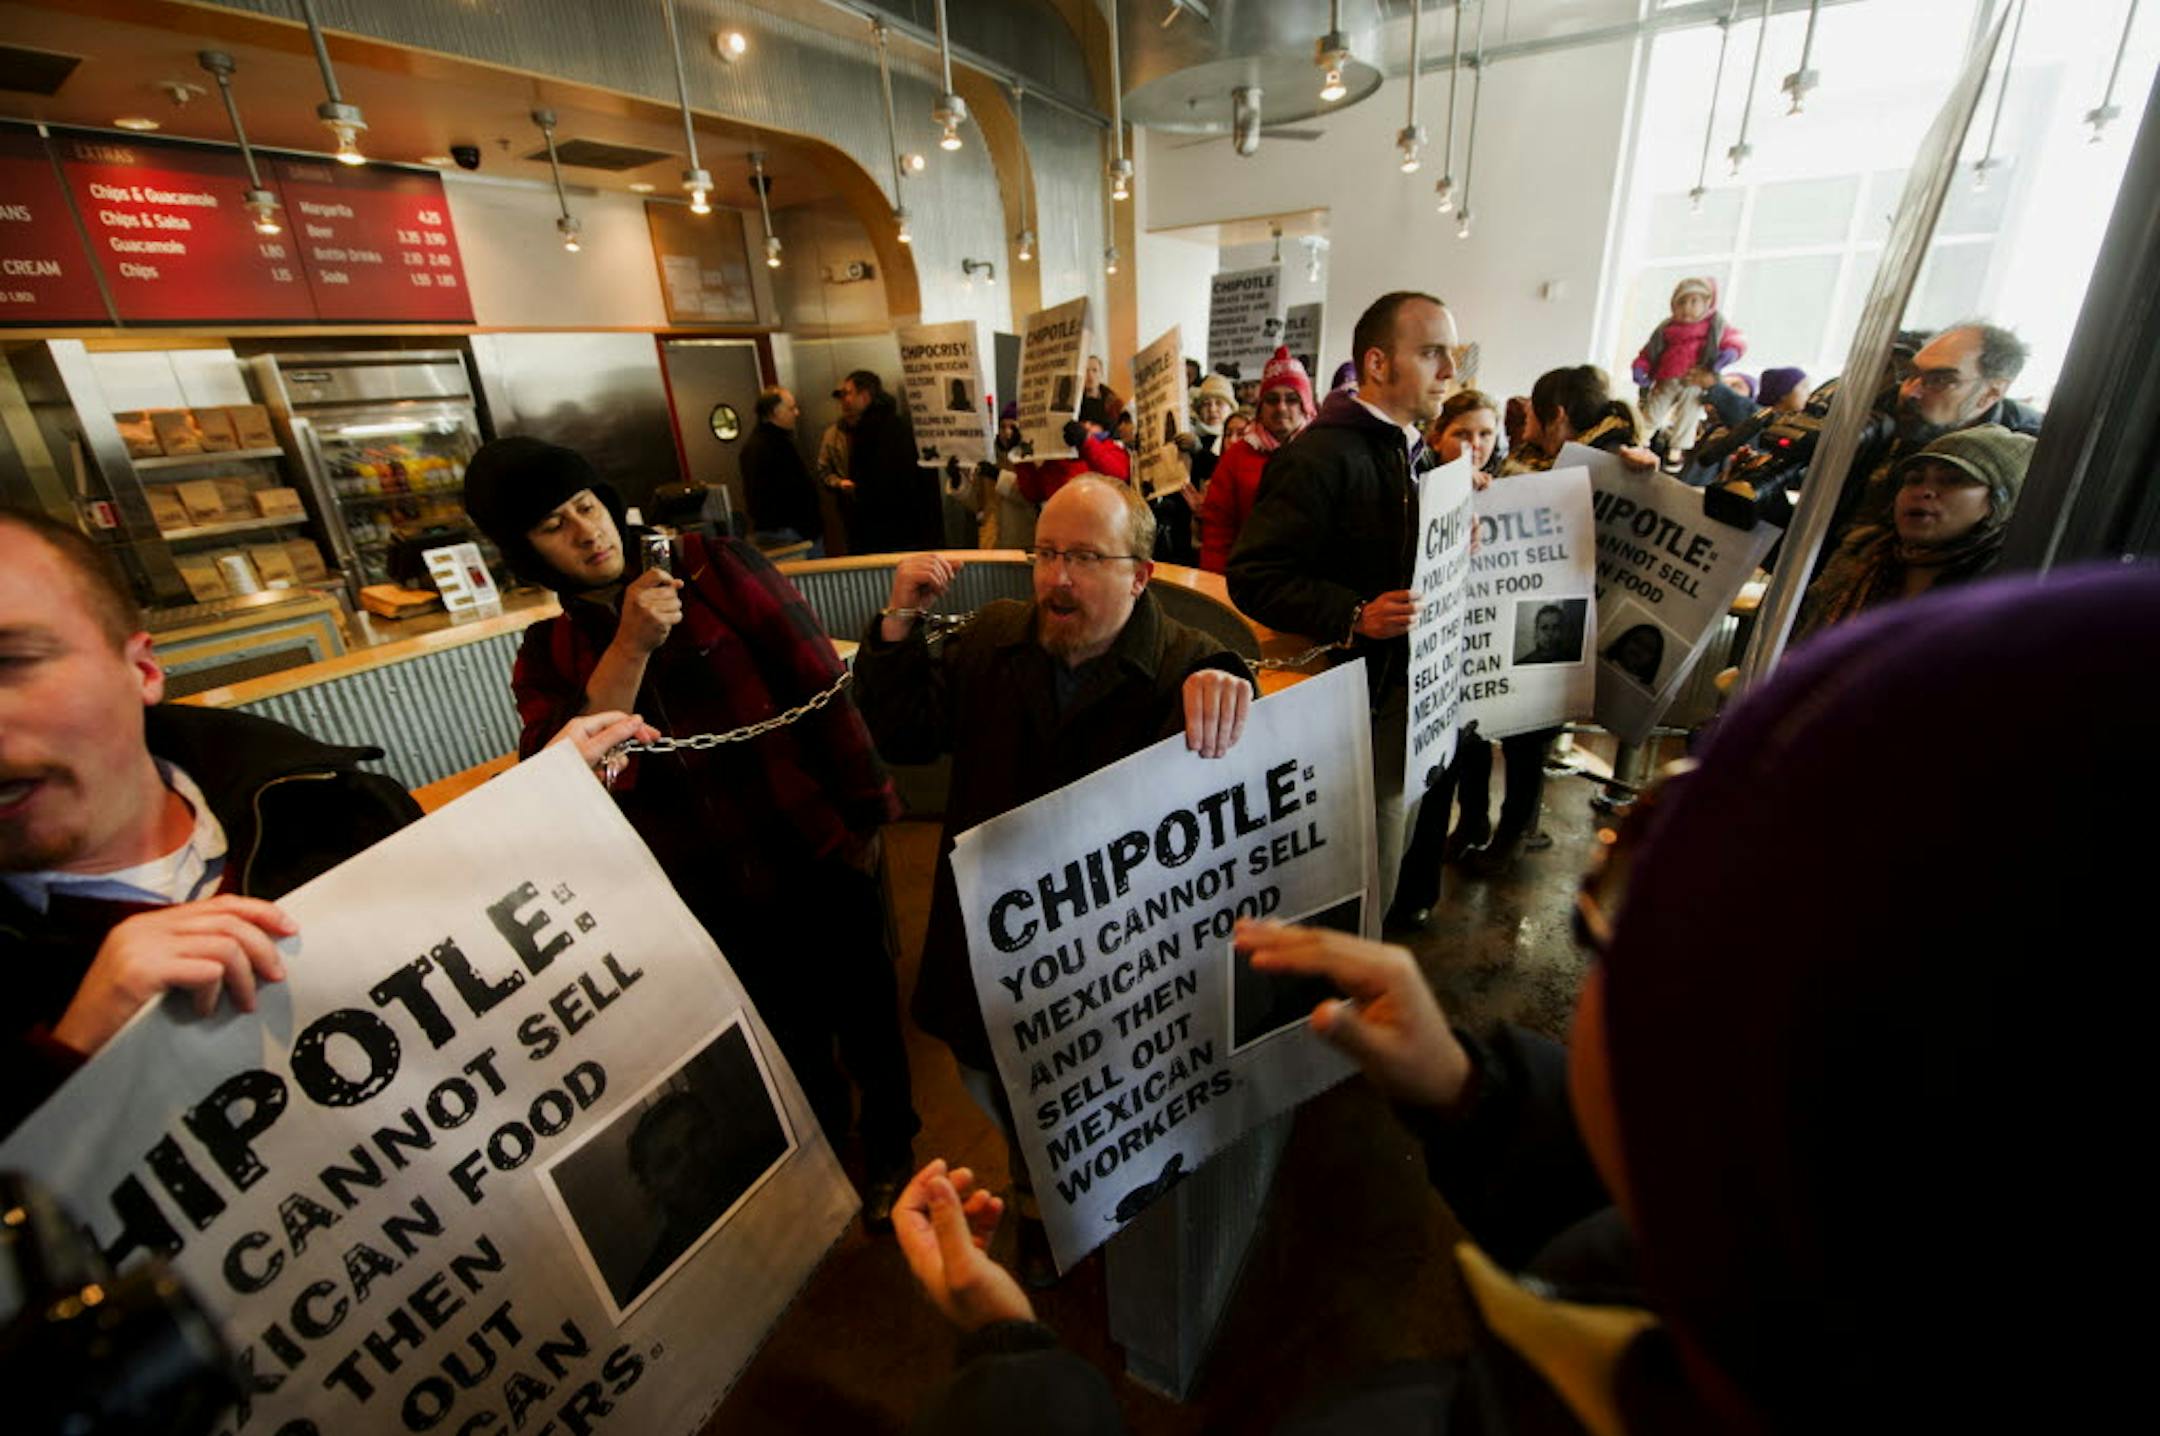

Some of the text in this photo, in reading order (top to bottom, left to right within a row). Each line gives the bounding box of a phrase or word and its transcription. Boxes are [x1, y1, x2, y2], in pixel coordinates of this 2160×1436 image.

[90, 183, 218, 207] Chips & Guacamole
[100, 210, 191, 231] Chips & Salsa
[109, 237, 187, 255] Guacamole
[3, 259, 62, 277] CREAM
[119, 262, 160, 280] Chips
[1479, 507, 1563, 546] OTLE:
[1470, 550, 1520, 573] NNOT
[1525, 543, 1569, 564] SELL
[1496, 573, 1543, 595] FOOD
[1614, 568, 1664, 604] FOOD
[1658, 562, 1700, 600] SELL
[1463, 606, 1497, 627] HEN
[1414, 661, 1440, 694] SELL
[988, 759, 1318, 954] CHIPOTLE:
[1000, 821, 1327, 1004] YOU CANNOT SELL
[1013, 932, 1181, 1053] MEXICAN
[1028, 969, 1199, 1096] AND THEN
[84, 880, 597, 1266] HIPOTLE:
[1036, 1013, 1193, 1131] SELL OUT
[222, 951, 646, 1295] CANNOT SELL
[1046, 1039, 1214, 1172] MEXICAN
[234, 1195, 446, 1432] XICAN
[448, 1059, 609, 1205] FOOD
[322, 1233, 507, 1405] THEN
[401, 1300, 524, 1434] OUT
